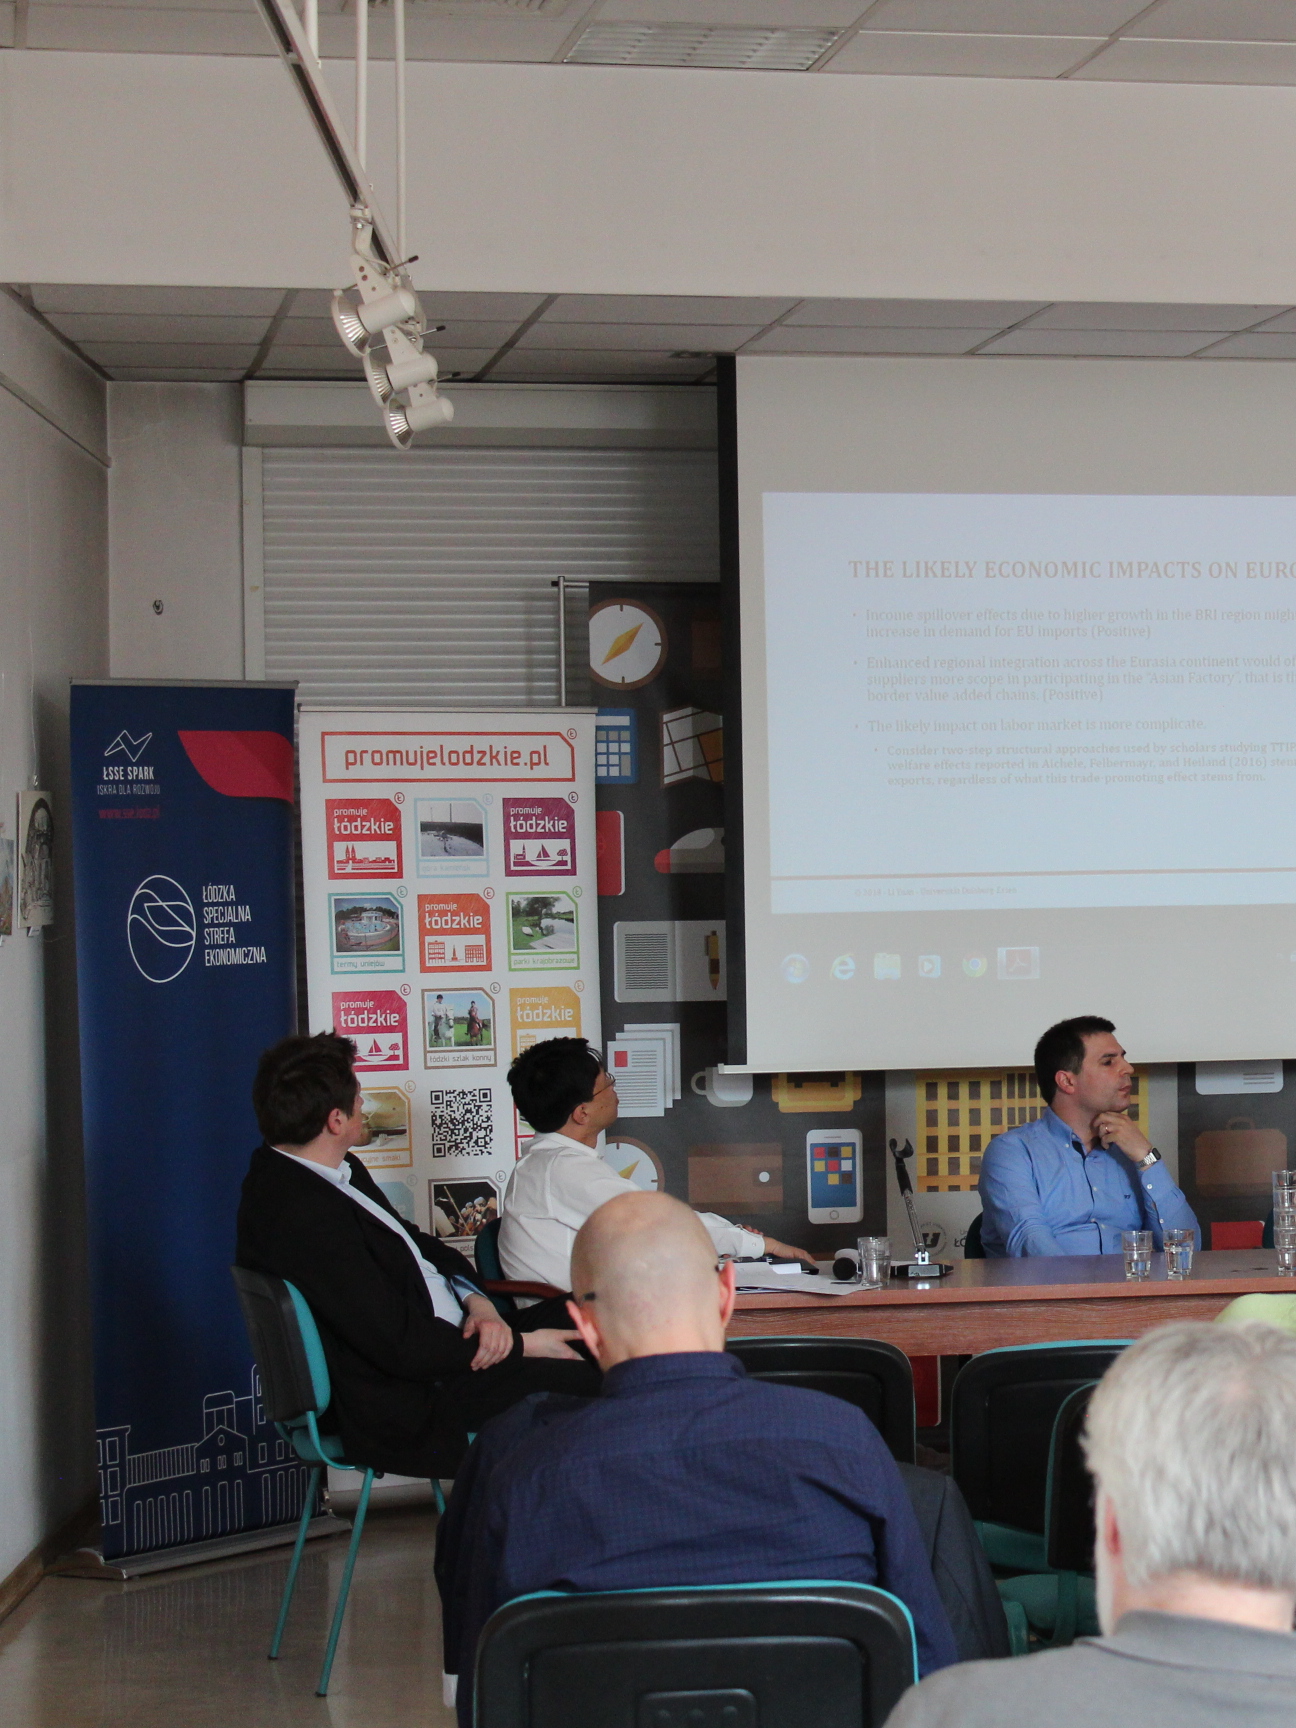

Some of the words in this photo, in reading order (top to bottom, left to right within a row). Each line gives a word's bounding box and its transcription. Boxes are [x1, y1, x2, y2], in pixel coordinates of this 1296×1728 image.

[849, 560, 894, 579] THE
[901, 560, 976, 579] LIKELY
[984, 560, 1101, 579] ECONOMIC
[1108, 560, 1201, 579] IMPACTS
[1208, 560, 1238, 579] ON
[865, 608, 913, 620] Income
[917, 608, 970, 623] spillover
[976, 608, 1017, 620] effects
[1020, 608, 1044, 620] due
[1047, 608, 1060, 620] to
[1063, 608, 1102, 623] higher
[1107, 608, 1152, 623] growth
[1156, 608, 1168, 620] in
[1171, 608, 1191, 620] the
[1194, 608, 1217, 620] BRI
[1220, 608, 1260, 623] region
[866, 625, 920, 637] increase
[923, 625, 935, 637] in
[938, 625, 991, 637] demand
[994, 625, 1010, 637] for
[1016, 625, 1034, 637] EU
[1037, 625, 1087, 640] imports
[1090, 625, 1151, 640] (Positive)
[866, 656, 930, 667] Enhanced
[933, 656, 985, 670] regional
[989, 656, 1059, 670] integration
[1106, 656, 1126, 666] the
[1129, 655, 1176, 666] Eurasia
[1178, 655, 1239, 666] continent
[1242, 655, 1280, 666] would
[866, 673, 926, 688] suppliers
[930, 676, 964, 684] more
[967, 676, 1003, 688] scope
[1006, 672, 1019, 684] in
[1022, 672, 1104, 687] participating
[1106, 672, 1119, 684] in
[1122, 672, 1142, 684] the
[1244, 671, 1268, 683] that
[1272, 671, 1282, 683] is
[866, 689, 910, 701] border
[914, 689, 948, 700] value
[952, 689, 992, 700] added
[1042, 688, 1103, 703] (Positive)
[868, 720, 892, 732] The
[895, 720, 930, 735] likely
[933, 719, 976, 734] impact
[980, 722, 997, 731] on
[1000, 719, 1034, 731] labor
[1036, 719, 1082, 730] market
[1085, 718, 1096, 730] is
[1099, 721, 1132, 730] more
[345, 745, 549, 770] promujelodzkie.pl
[886, 746, 938, 755] Consider
[996, 745, 1052, 755] structural
[1055, 744, 1120, 757] approaches
[1123, 744, 1150, 754] used
[1152, 744, 1166, 756] by
[1170, 744, 1216, 754] scholars
[1219, 743, 1267, 756] studying
[887, 760, 930, 769] welfare
[933, 760, 970, 769] effects
[974, 759, 1024, 771] reported
[1027, 759, 1038, 768] in
[1158, 758, 1179, 768] and
[1228, 757, 1267, 770] (2016)
[1270, 757, 1296, 767] stem
[103, 766, 125, 780] ŁSSE
[127, 766, 155, 780] SPARK
[937, 774, 996, 786] regardless
[1000, 773, 1011, 783] of
[1014, 773, 1042, 783] what
[1045, 773, 1066, 783] this
[1166, 772, 1197, 782] effect
[1201, 772, 1233, 782] stems
[97, 784, 117, 795] ISKRA
[118, 784, 131, 795] DLA
[133, 784, 160, 795] ROZWOJU
[334, 806, 368, 817] promuje
[510, 805, 542, 815] promuje
[334, 817, 394, 835] łódzkie
[510, 816, 568, 834] łódzkie
[202, 883, 236, 903] ŁÓDZKA
[203, 905, 252, 924] SPECJALNA
[425, 902, 457, 912] promuje
[424, 912, 483, 930] łódzkie
[204, 927, 236, 945] STREFA
[205, 947, 267, 966] EKONOMICZNA
[336, 959, 358, 969] termy
[340, 999, 374, 1010] promuje
[517, 995, 549, 1006] promuje
[340, 1010, 400, 1028] łódzkie
[517, 1006, 574, 1022] łódzkie
[429, 1053, 450, 1063] łódzki
[452, 1053, 470, 1062] szlak
[471, 1053, 492, 1063] konny
